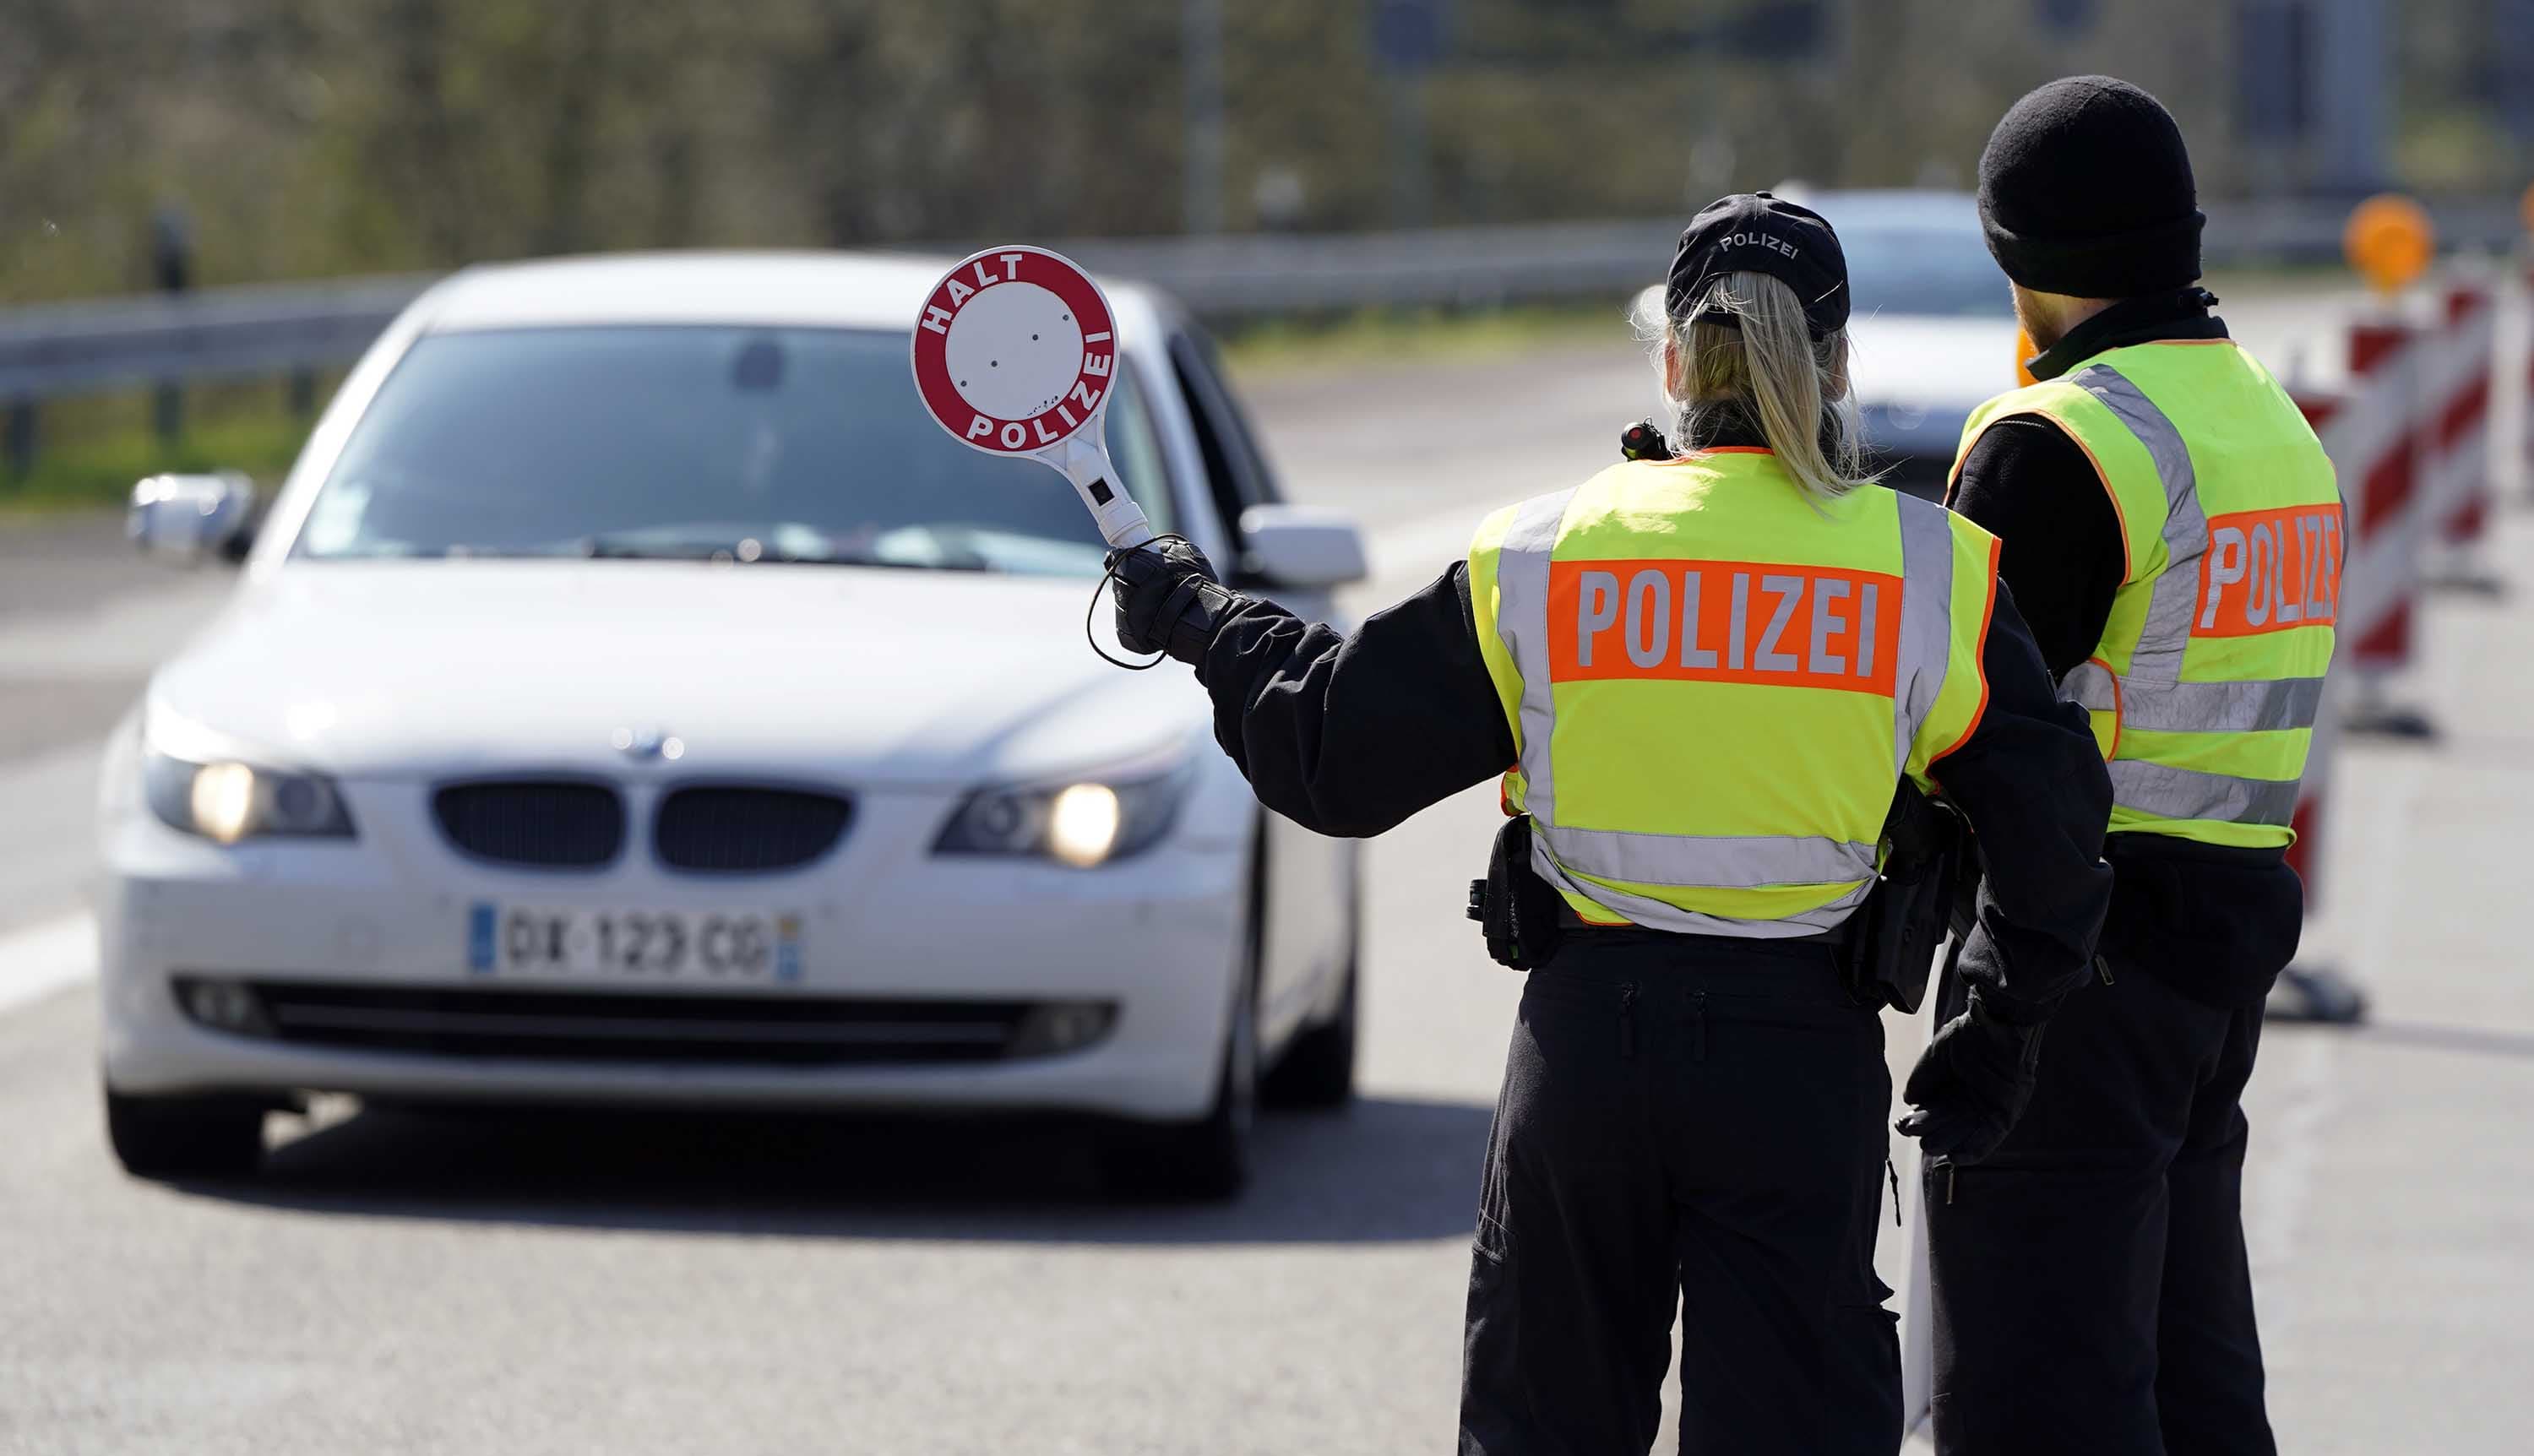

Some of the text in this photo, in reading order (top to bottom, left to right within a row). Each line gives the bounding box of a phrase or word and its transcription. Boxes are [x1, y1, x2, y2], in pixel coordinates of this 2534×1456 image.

[1719, 231, 1799, 260] POLIZEI
[922, 253, 1023, 335] HALT
[965, 330, 1112, 449] POLIZEI
[1577, 568, 1879, 677] POLIZEI
